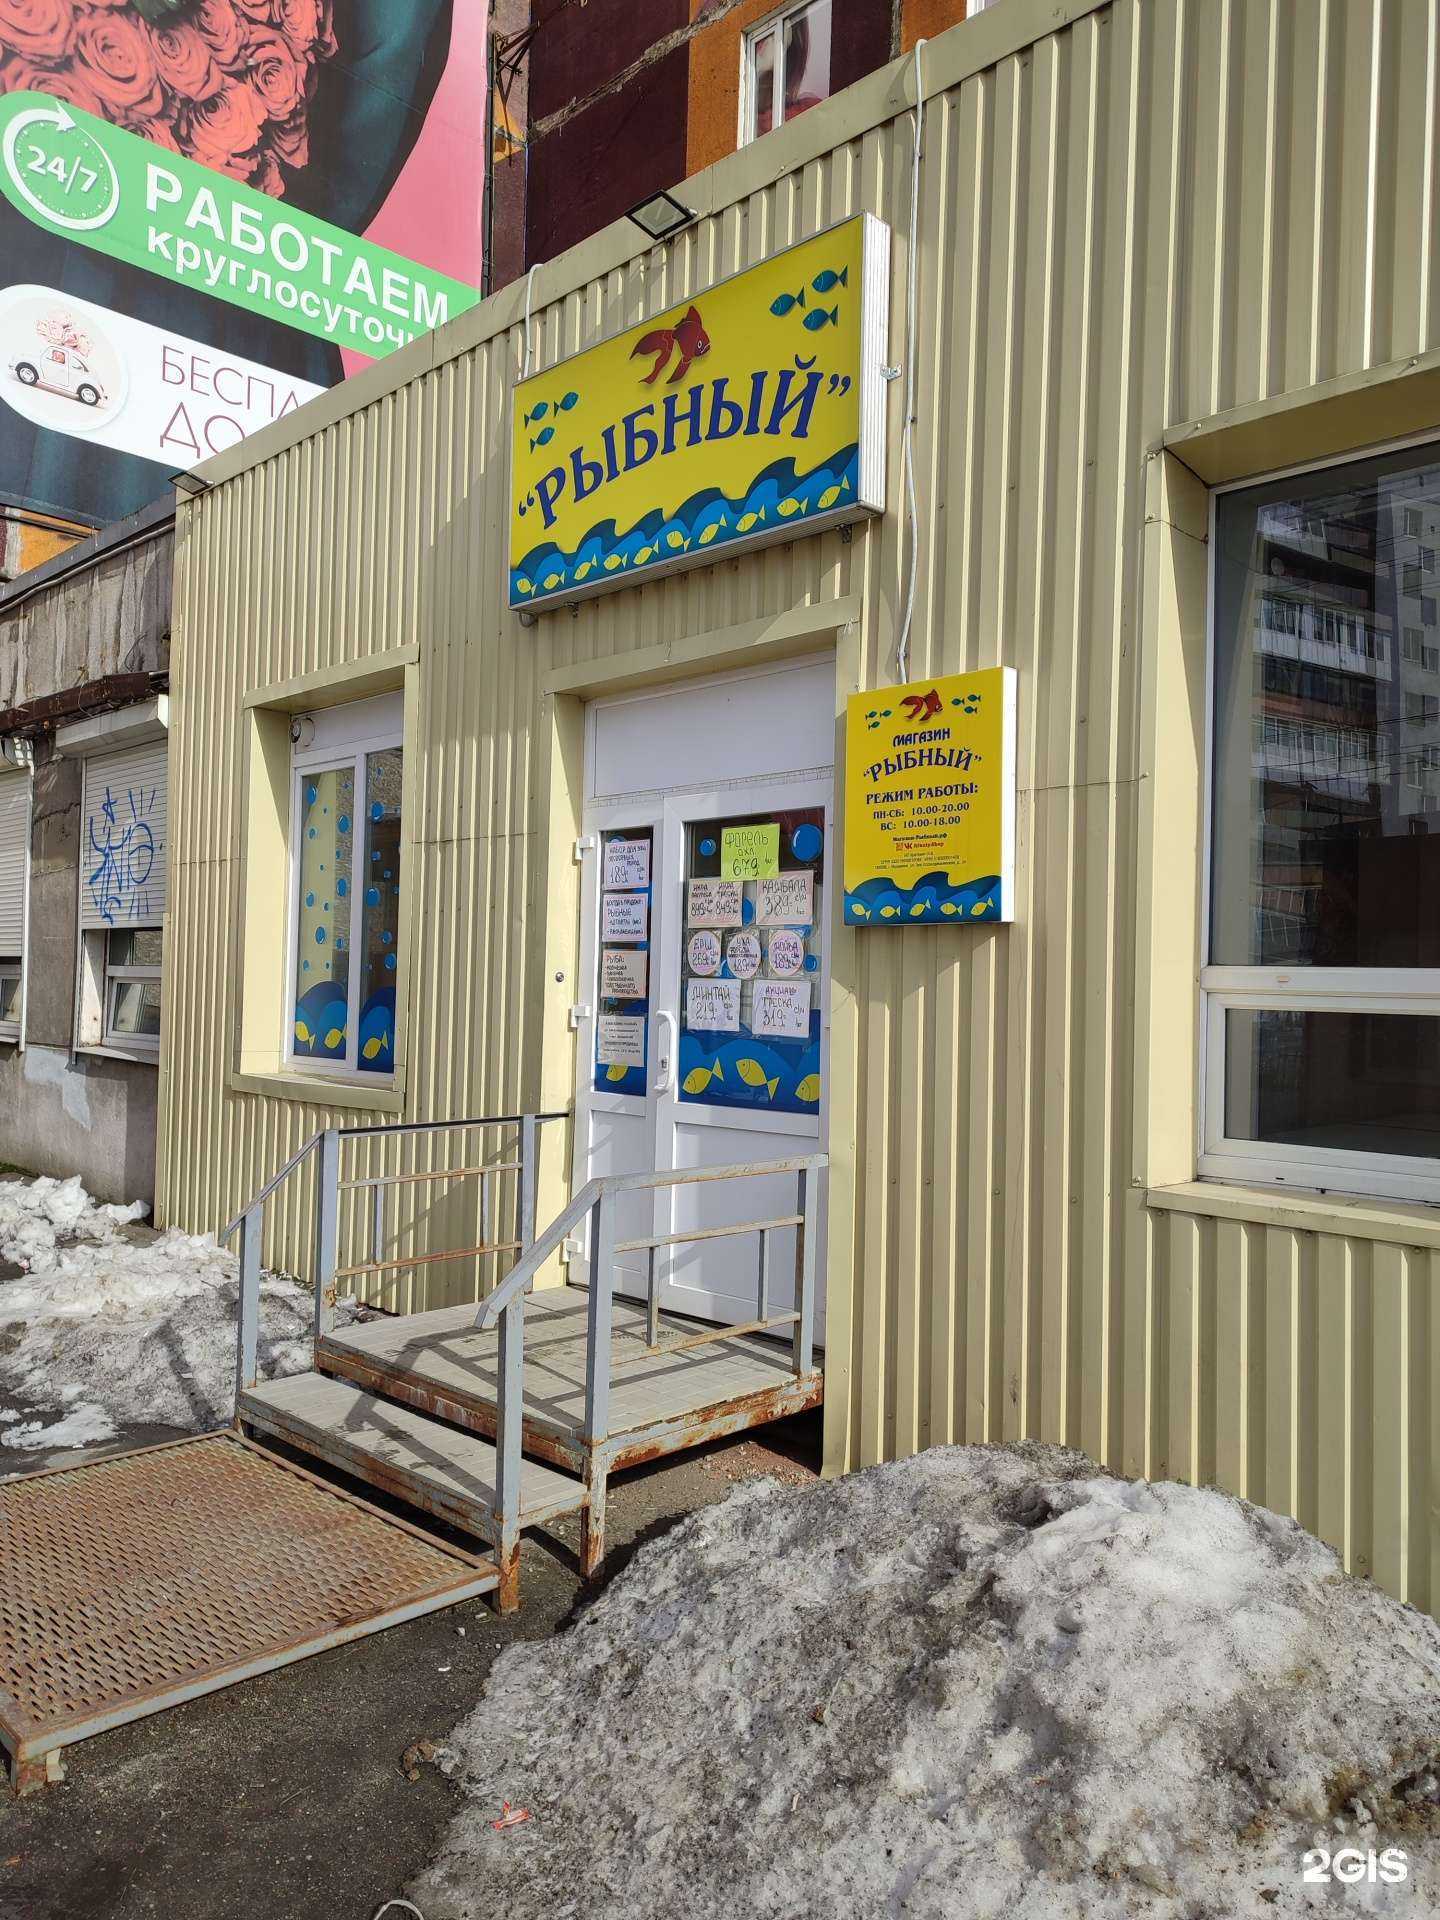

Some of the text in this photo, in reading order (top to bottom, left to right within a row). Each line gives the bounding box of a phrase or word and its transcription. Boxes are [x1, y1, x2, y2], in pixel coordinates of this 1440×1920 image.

[26, 144, 98, 195] 24/7
[145, 161, 448, 328] РАБОТАЕМ
[147, 224, 414, 348] круглосуточ
[892, 727, 951, 747] МАГАЗИН
[866, 782, 979, 805] РЕЖИМ РАБОТЫ:
[872, 802, 970, 820] ПН-СБ: 10.00-20.00
[880, 815, 961, 831] ВС: 10.00-18.00
[725, 831, 769, 848] ФОРЕЛЬ
[732, 858, 759, 877] 679
[762, 879, 807, 894] КАМБАЛА
[762, 997, 793, 1009] ТРЕСКА
